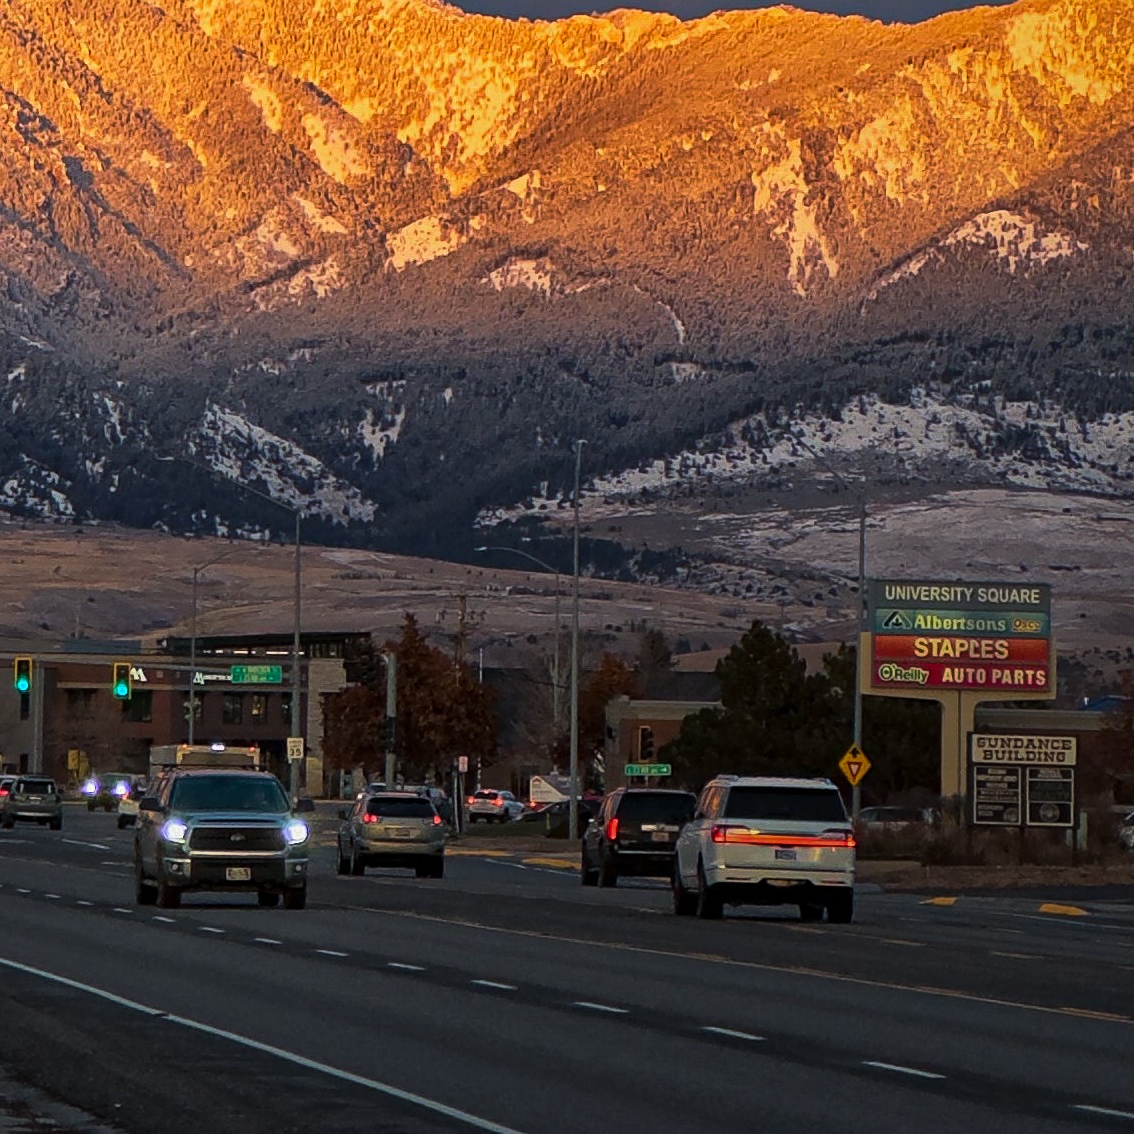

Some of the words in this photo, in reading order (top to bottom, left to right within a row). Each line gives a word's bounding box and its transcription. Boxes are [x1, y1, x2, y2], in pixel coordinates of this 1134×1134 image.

[885, 585, 973, 603] UNIVERSITY
[977, 587, 1041, 604] SQUARE
[914, 614, 1006, 632] Albertsons
[913, 638, 1009, 659] STAPLES
[878, 663, 929, 685] O'Reilly
[941, 667, 987, 684] AUTO
[992, 668, 1047, 686] PARTS
[977, 737, 1072, 751] SUNDANCE
[983, 750, 1066, 762] BUILDING
